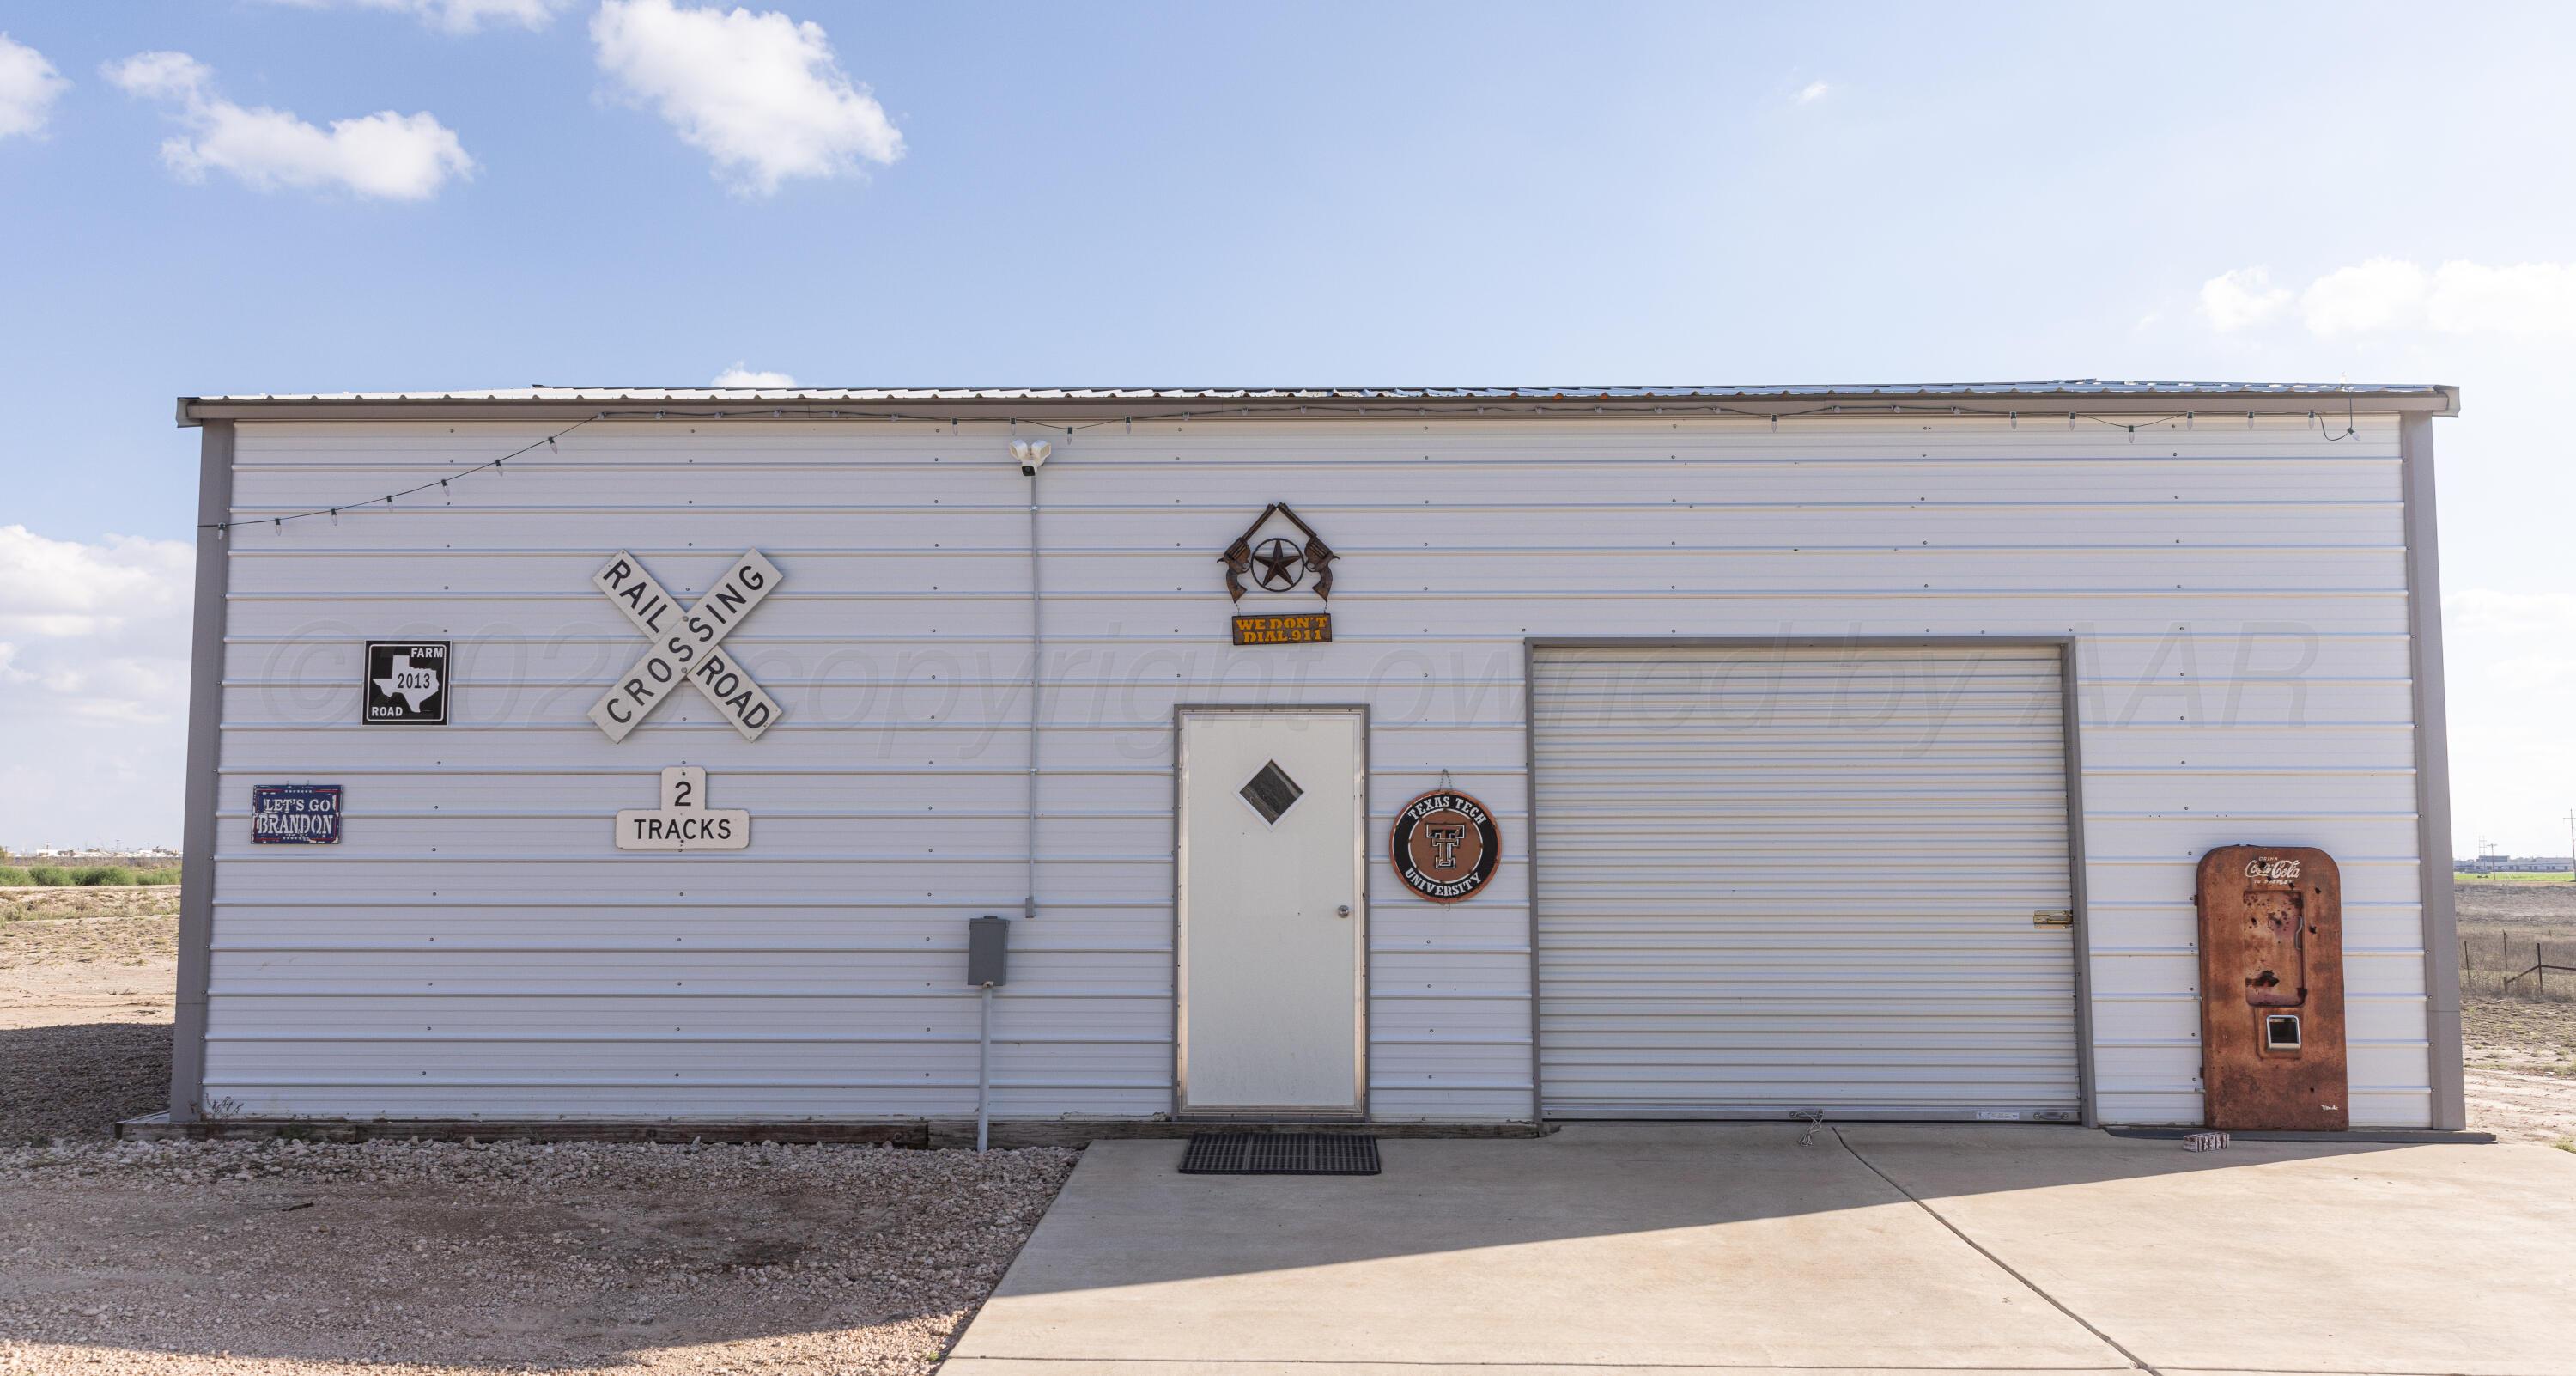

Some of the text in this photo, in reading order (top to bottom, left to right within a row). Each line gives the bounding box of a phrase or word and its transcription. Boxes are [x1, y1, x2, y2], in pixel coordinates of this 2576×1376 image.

[1236, 617, 1327, 630] WE DON'T
[603, 559, 770, 729] RAIL ROAD
[606, 565, 764, 724] CROSSING
[1243, 630, 1322, 642] DIAL 911
[410, 648, 444, 658] FARM
[397, 673, 430, 689] 2013
[371, 706, 404, 716] ROAD
[674, 781, 692, 807] 2
[264, 799, 331, 812] LET'S GO
[1407, 796, 1487, 825] TEXAS TECH
[258, 813, 333, 834] BRANDON
[634, 818, 732, 840] TRACKS
[1405, 867, 1481, 897] UNIVERSITY
